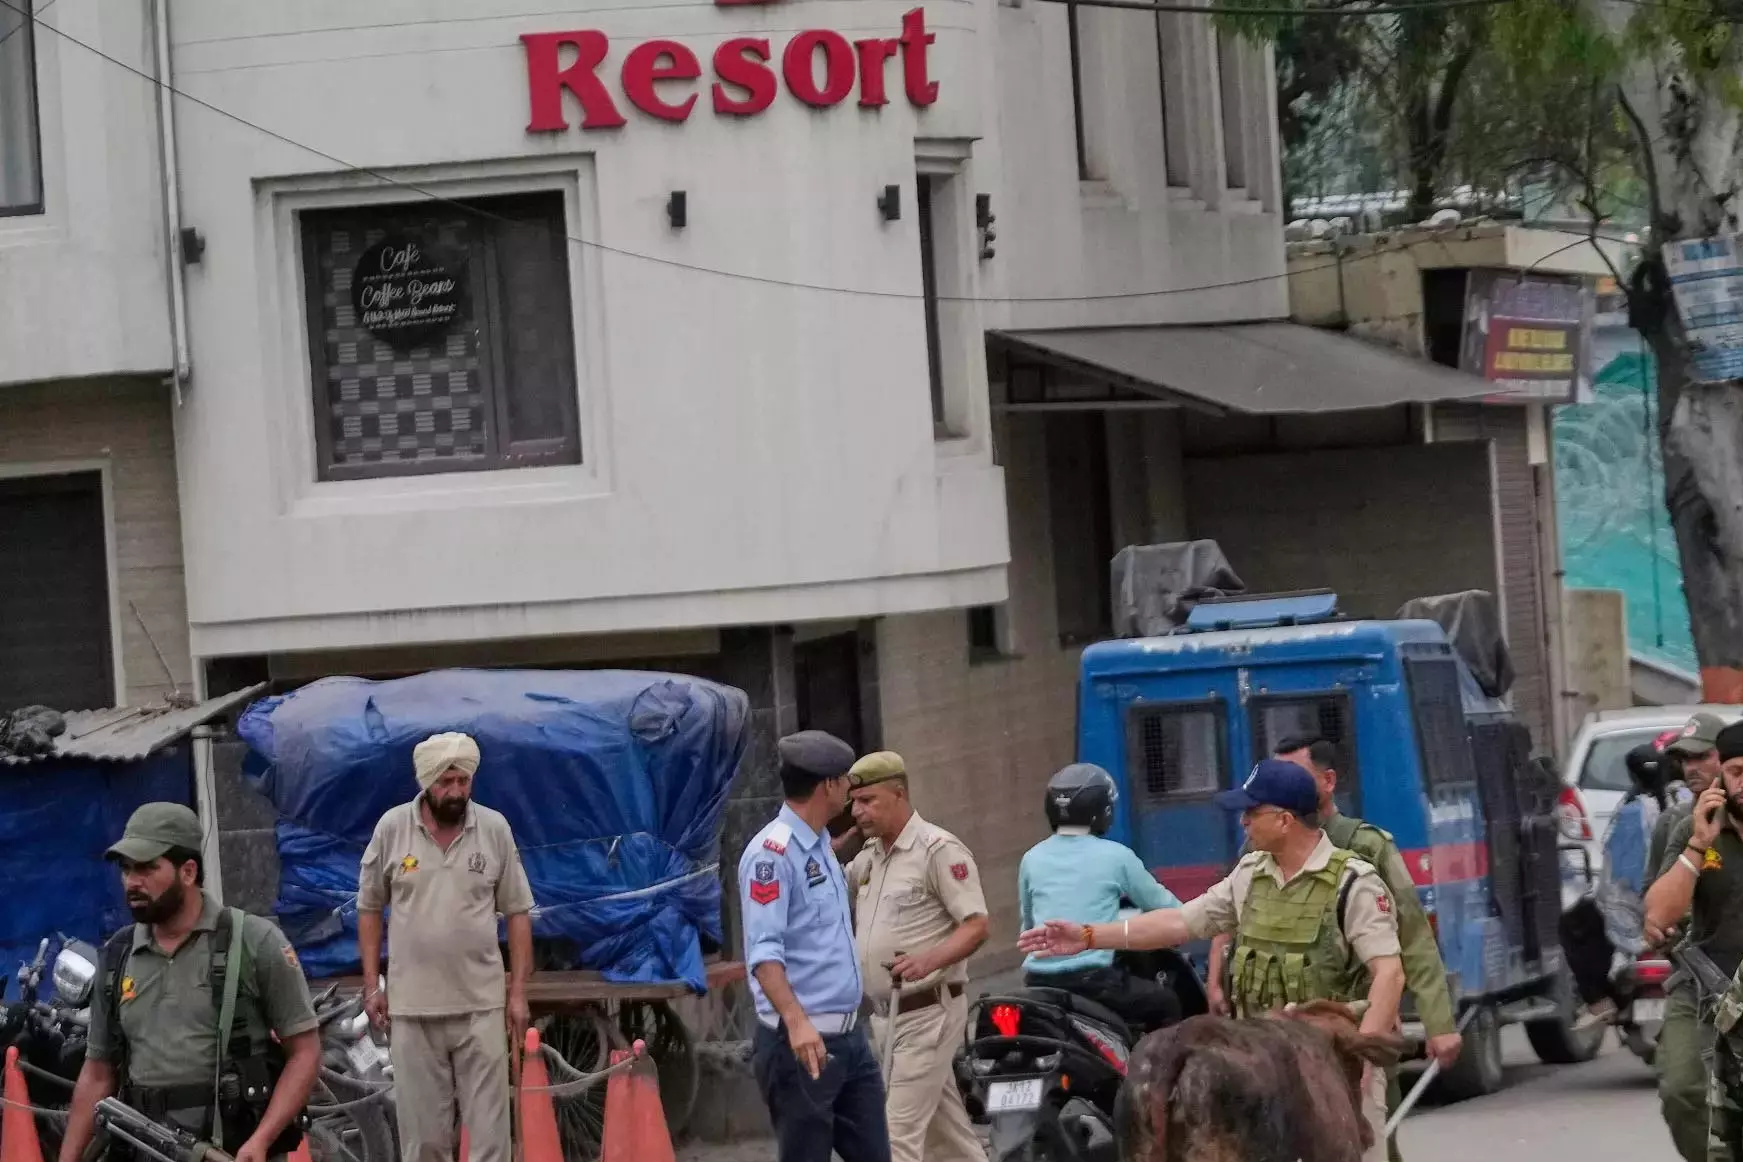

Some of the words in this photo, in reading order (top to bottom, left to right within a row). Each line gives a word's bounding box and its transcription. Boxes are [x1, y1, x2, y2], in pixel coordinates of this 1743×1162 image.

[518, 7, 940, 133] Resort
[361, 283, 405, 308] Coffee
[407, 279, 456, 305] Beans
